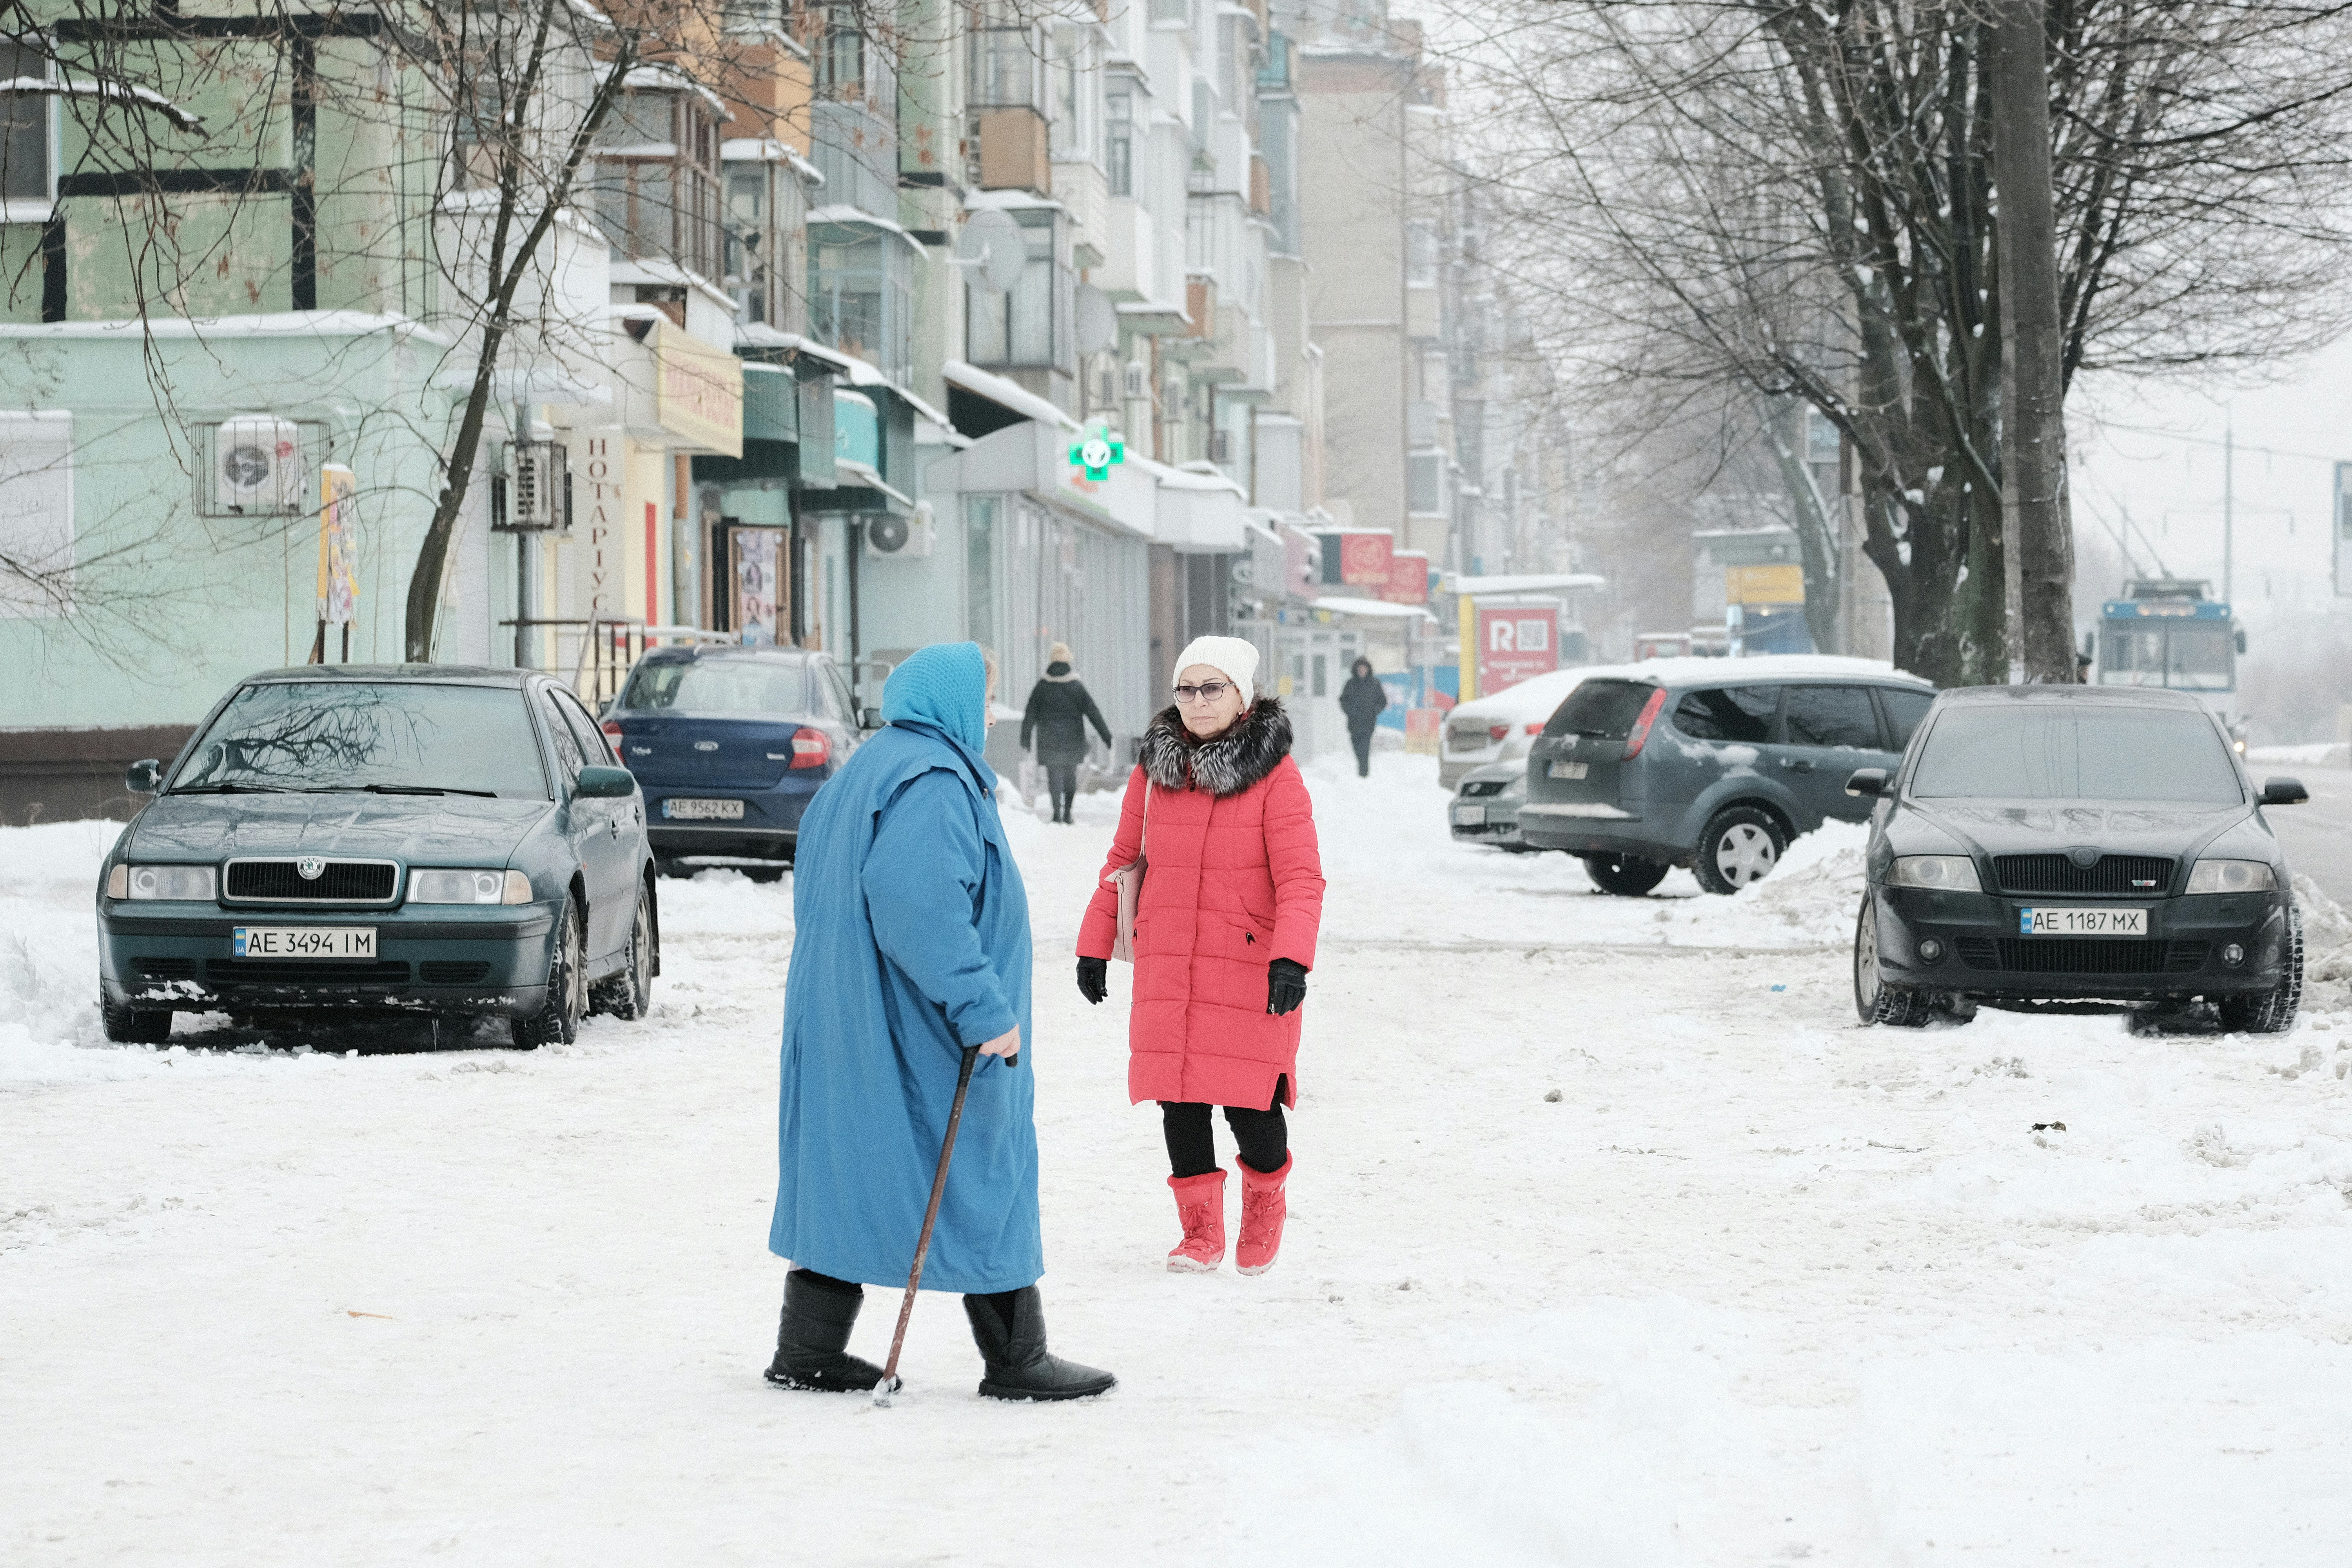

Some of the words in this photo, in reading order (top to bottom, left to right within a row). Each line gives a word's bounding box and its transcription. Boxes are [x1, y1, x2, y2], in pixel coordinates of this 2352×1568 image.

[670, 802, 686, 813] AE
[691, 801, 718, 814] 9562
[722, 802, 739, 814] KX
[2033, 912, 2059, 930] AE
[2066, 913, 2107, 930] 1187
[2113, 913, 2139, 931] MX
[249, 933, 278, 953] AE
[285, 933, 333, 953] 3494
[345, 933, 370, 953] IM
